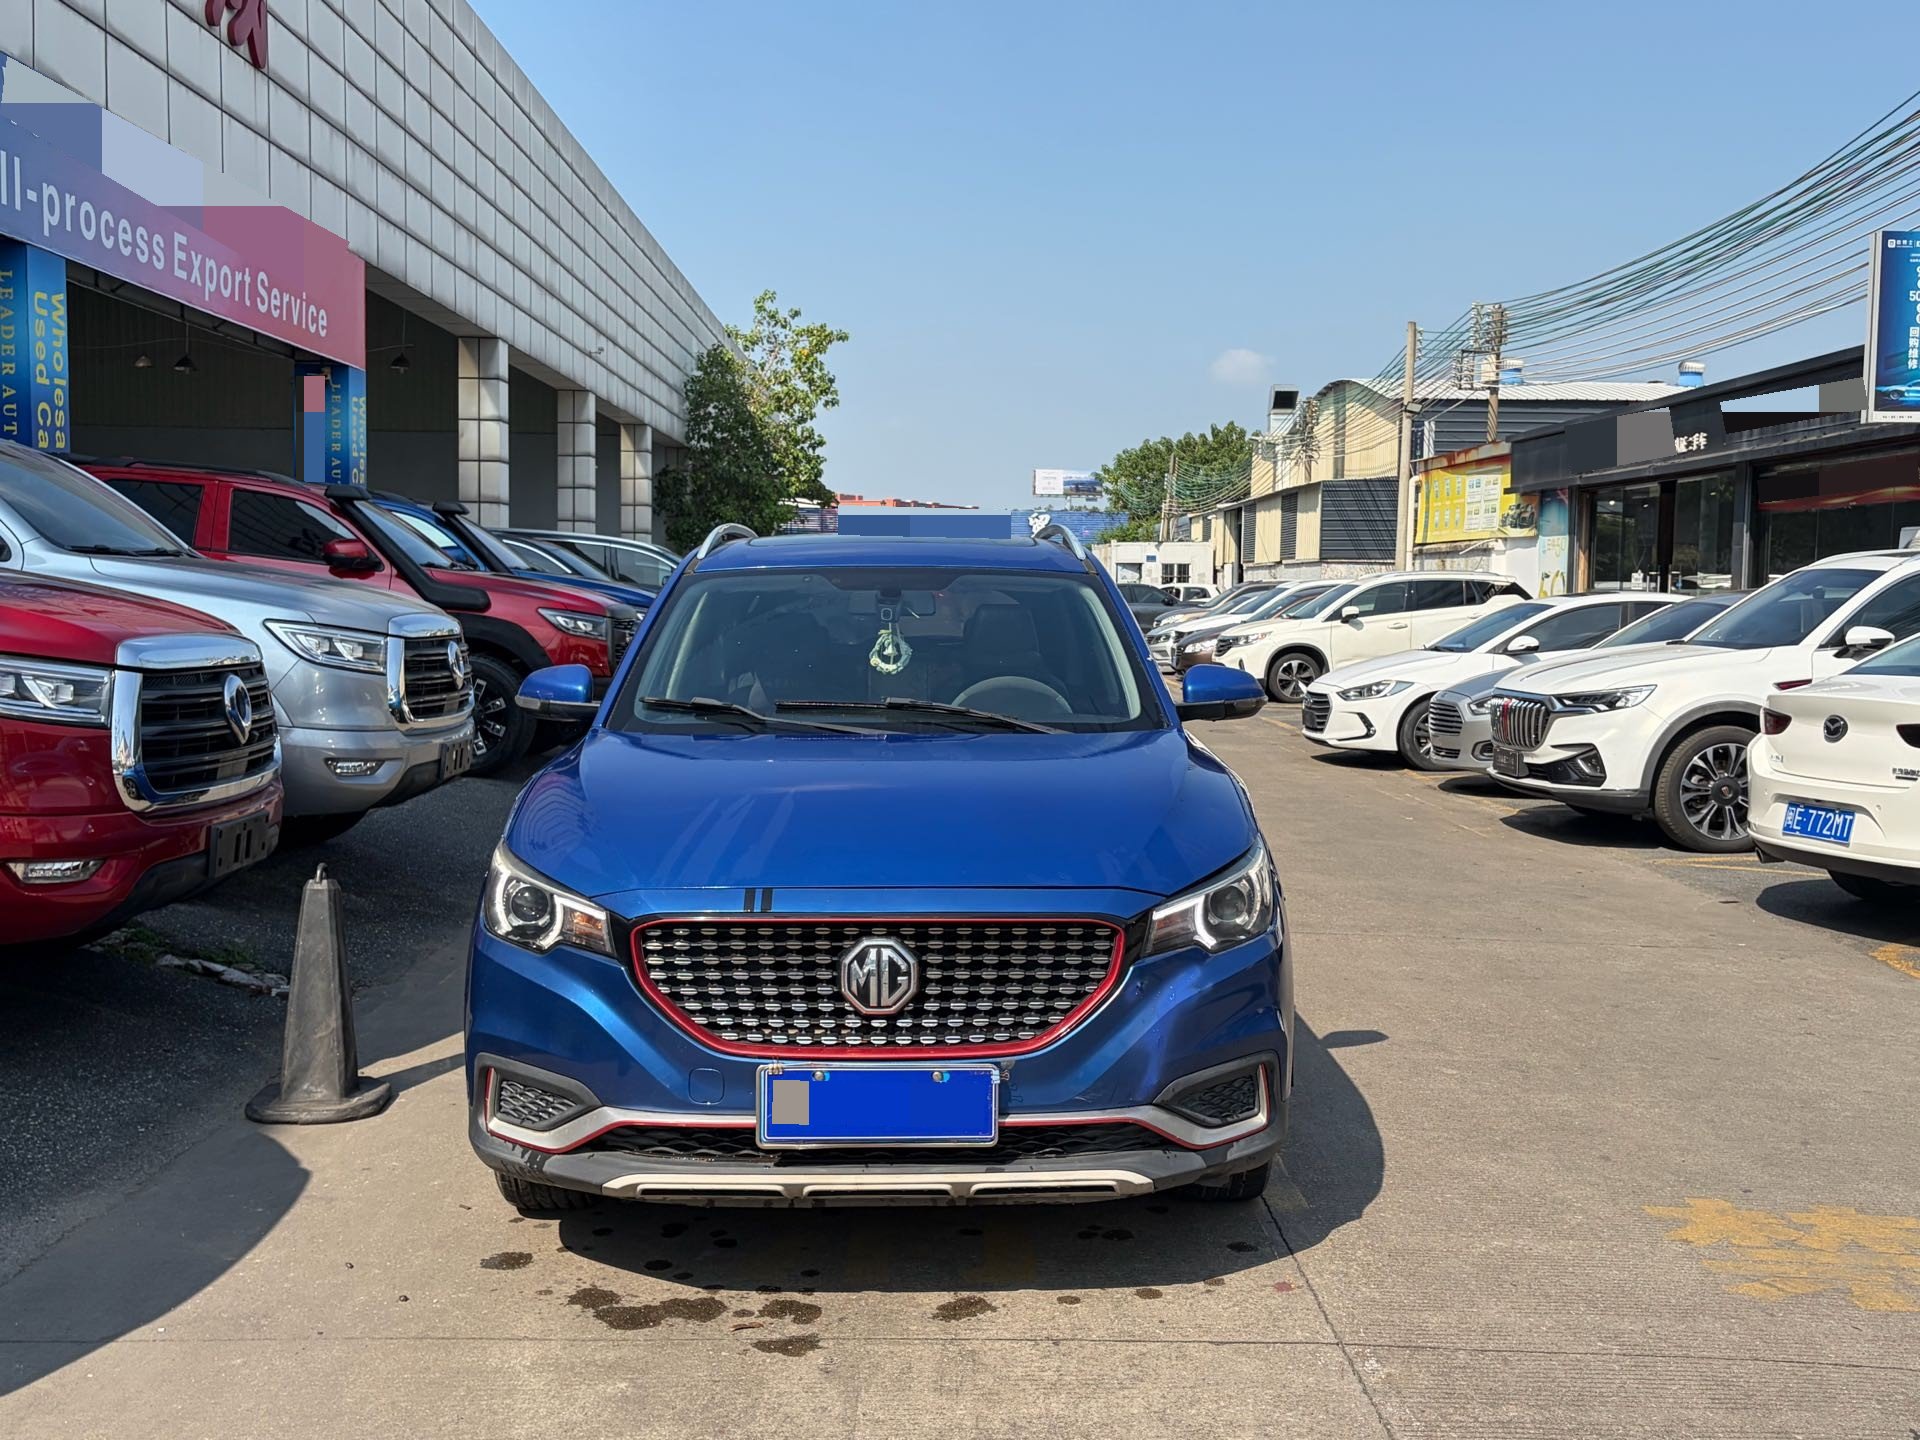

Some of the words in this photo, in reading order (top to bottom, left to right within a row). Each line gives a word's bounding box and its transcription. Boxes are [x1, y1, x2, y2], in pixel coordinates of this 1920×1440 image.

[174, 231, 250, 306] Export
[256, 271, 328, 337] Service
[0, 270, 16, 376] LEADER
[34, 291, 50, 386] Used
[2, 384, 18, 442] AUT
[331, 457, 341, 482] AU
[849, 947, 909, 1007] MG
